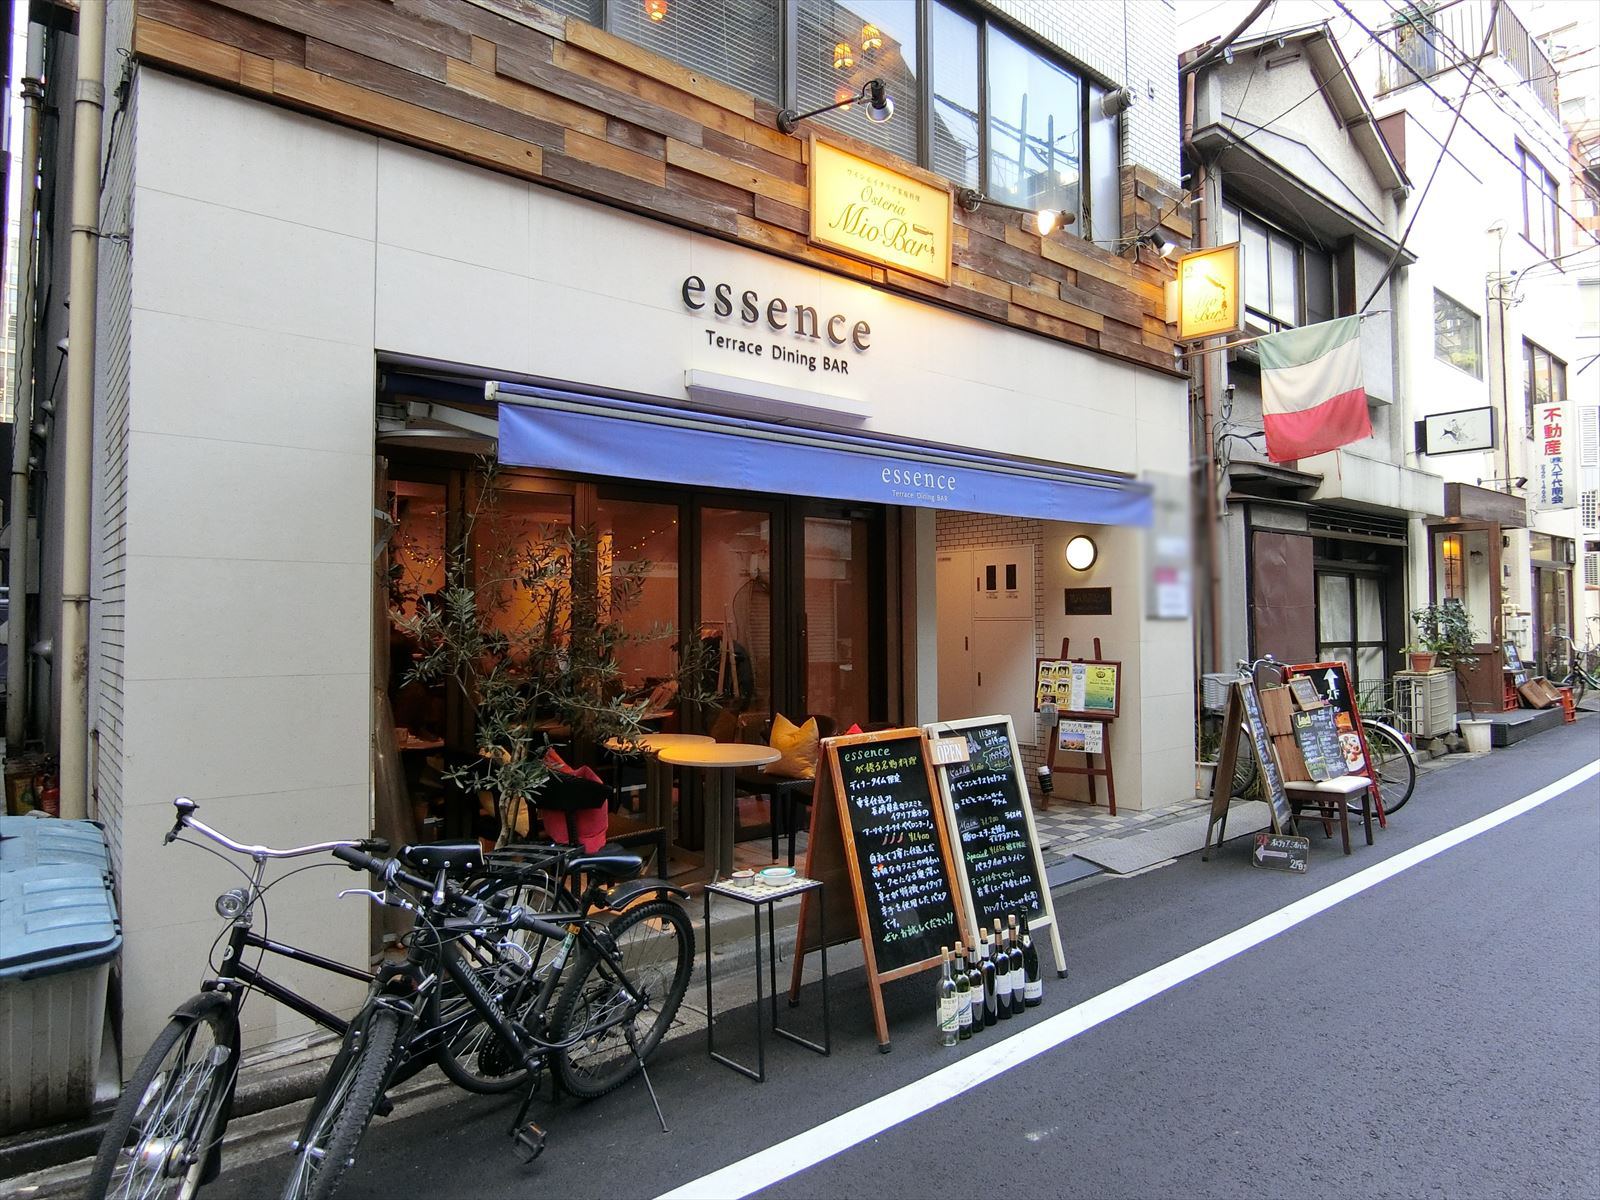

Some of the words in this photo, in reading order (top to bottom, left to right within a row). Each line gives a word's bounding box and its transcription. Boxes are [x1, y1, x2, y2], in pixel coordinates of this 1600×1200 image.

[861, 186, 907, 217] Osteria
[829, 202, 880, 245] Mio
[882, 218, 931, 257] Bar
[682, 275, 872, 351] essence
[706, 330, 763, 356] Terrace
[772, 345, 817, 371] Dining
[823, 357, 849, 375] BAR
[1543, 407, 1562, 456] 不動産
[881, 467, 956, 490] essence
[892, 490, 914, 499] Terrace
[917, 492, 935, 503] Dining
[1327, 689, 1340, 701] 2F
[844, 747, 891, 762] essence
[937, 743, 963, 762] OPEN
[855, 756, 918, 774] が誇る名物料理
[849, 773, 902, 790] ディナータイム限定
[950, 783, 956, 792] A
[954, 802, 960, 810] B
[959, 820, 979, 830] Main
[966, 847, 989, 863] Special
[456, 956, 506, 1024] BRIDGESTONE
